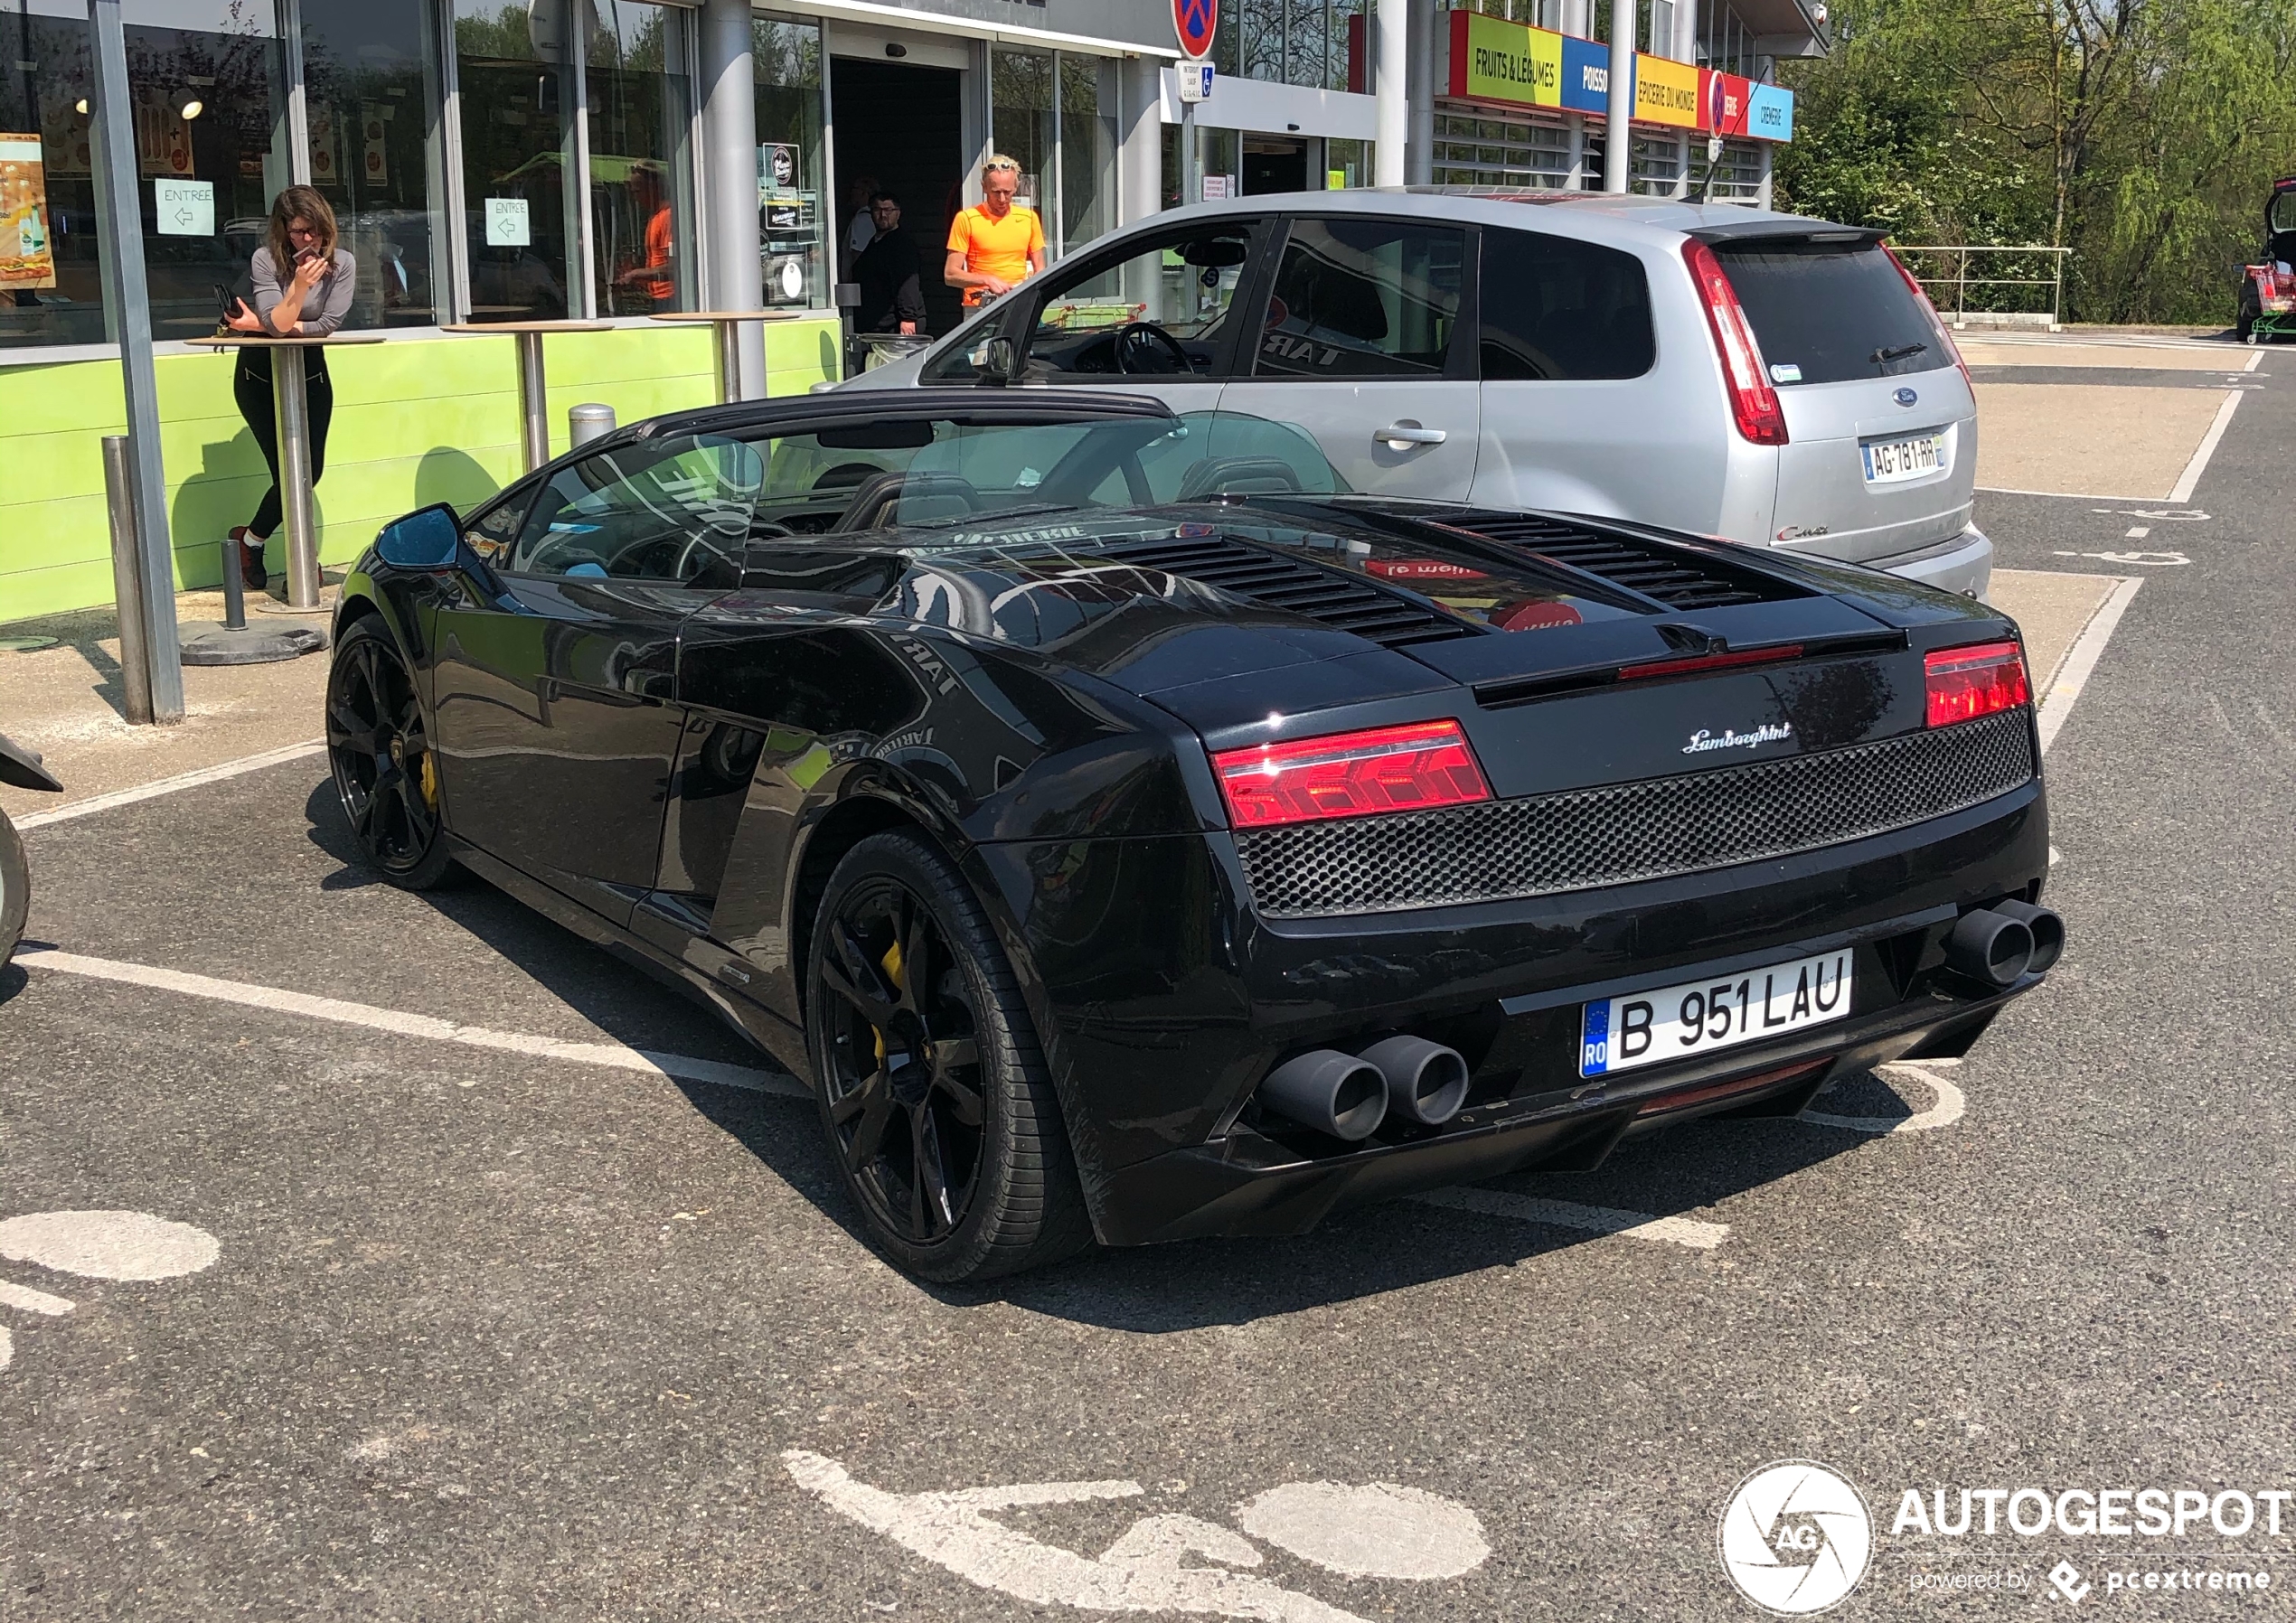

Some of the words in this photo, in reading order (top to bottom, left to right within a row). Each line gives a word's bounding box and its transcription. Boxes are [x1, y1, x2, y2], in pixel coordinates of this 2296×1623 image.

[1475, 47, 1508, 80] FRUITS
[1509, 53, 1516, 81] &
[1517, 50, 1555, 89] LÉGUMES
[1582, 65, 1608, 94] POISSO
[1638, 73, 1666, 108] ÉPICERIE
[1666, 86, 1675, 108] DU
[1675, 88, 1695, 112] MONDE
[165, 189, 212, 202] ENTREE
[495, 202, 526, 214] ENTREE
[1874, 439, 1936, 476] AG-781-RR
[1680, 722, 1791, 754] Lamborghini
[1619, 999, 1654, 1060] B
[1679, 978, 1751, 1046] 951
[1763, 956, 1844, 1028] LAU
[1585, 1041, 1606, 1066] RO
